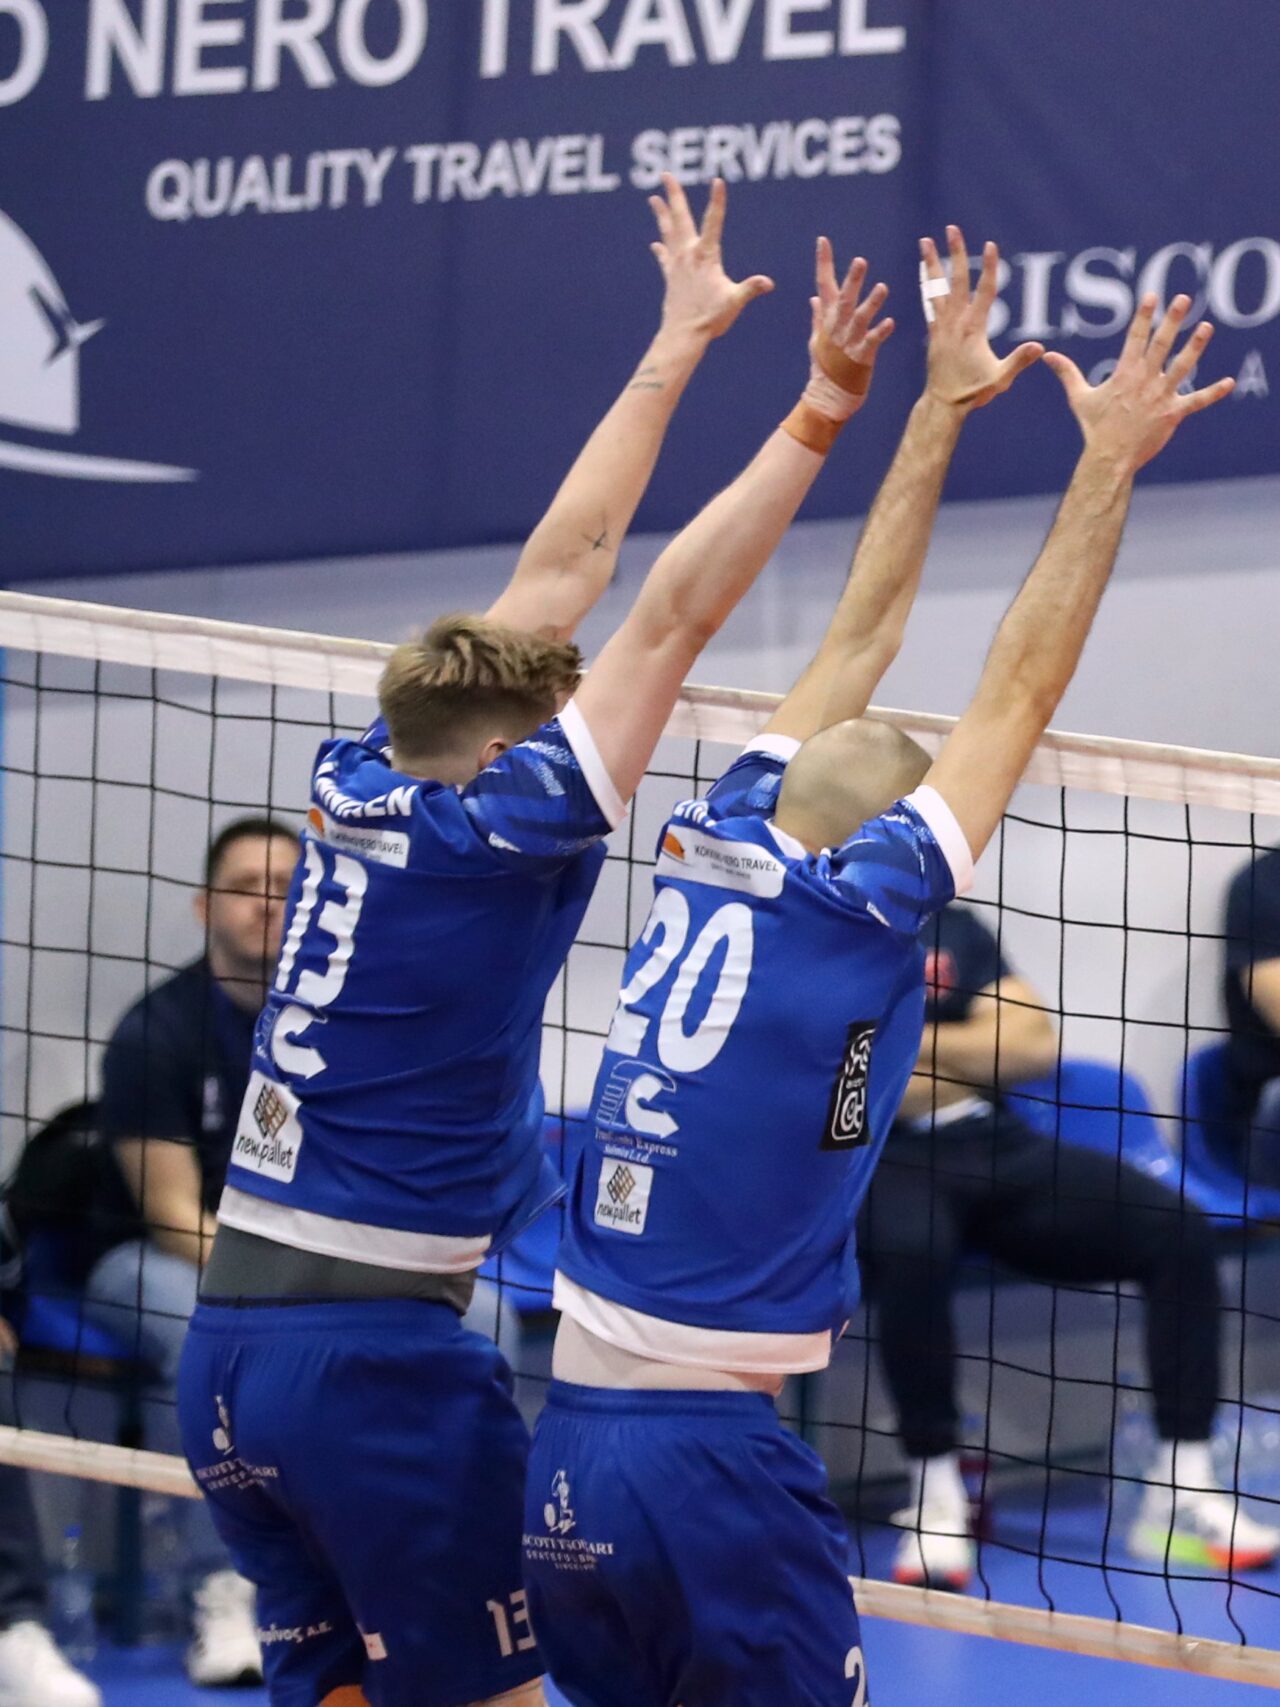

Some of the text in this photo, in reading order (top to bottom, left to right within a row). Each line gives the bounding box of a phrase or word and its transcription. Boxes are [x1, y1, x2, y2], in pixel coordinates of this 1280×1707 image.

[84, 0, 429, 101] NERO
[145, 113, 903, 220] QUALITY TRAVEL SERVICES
[274, 840, 368, 1007] 13
[605, 887, 754, 1073] 20
[486, 1588, 537, 1656] 13
